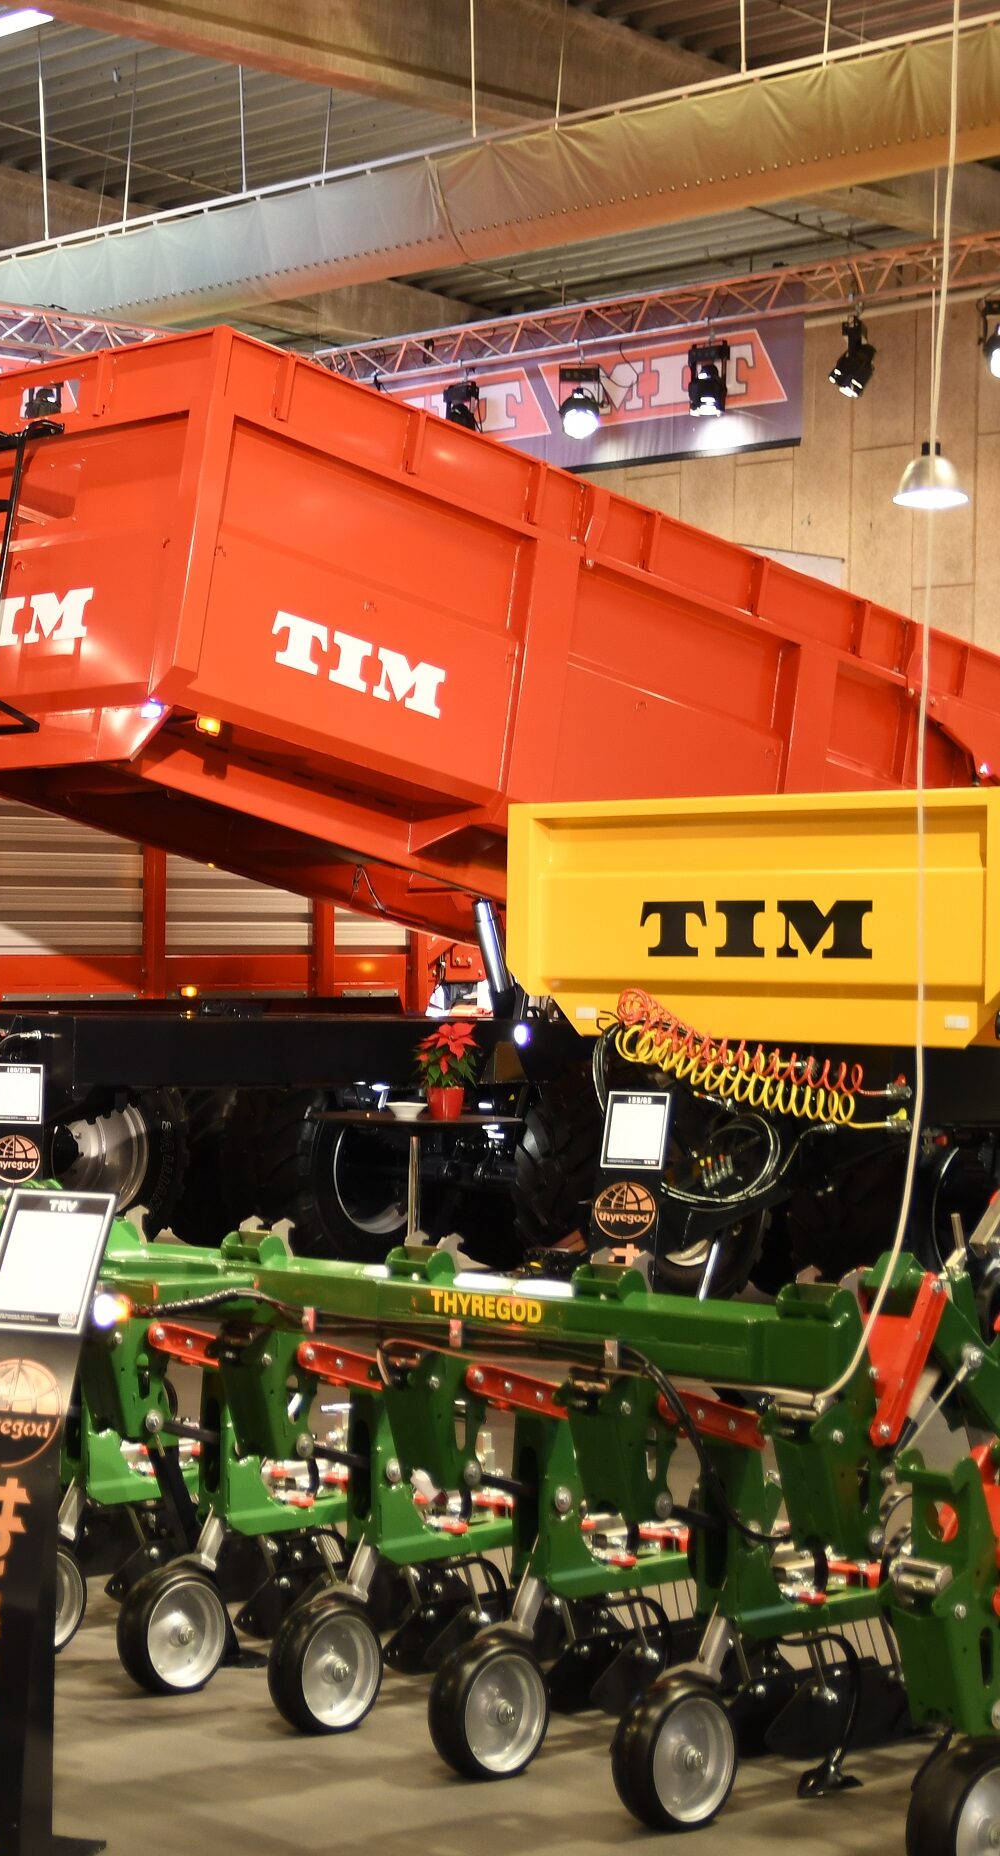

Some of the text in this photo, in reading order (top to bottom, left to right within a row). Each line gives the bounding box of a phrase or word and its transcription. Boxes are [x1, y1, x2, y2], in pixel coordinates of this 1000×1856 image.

[271, 610, 446, 719] TIM
[639, 899, 873, 960] TIM
[49, 1199, 78, 1212] TRV
[599, 1212, 650, 1225] thyregod
[430, 1289, 542, 1323] THYREGOD
